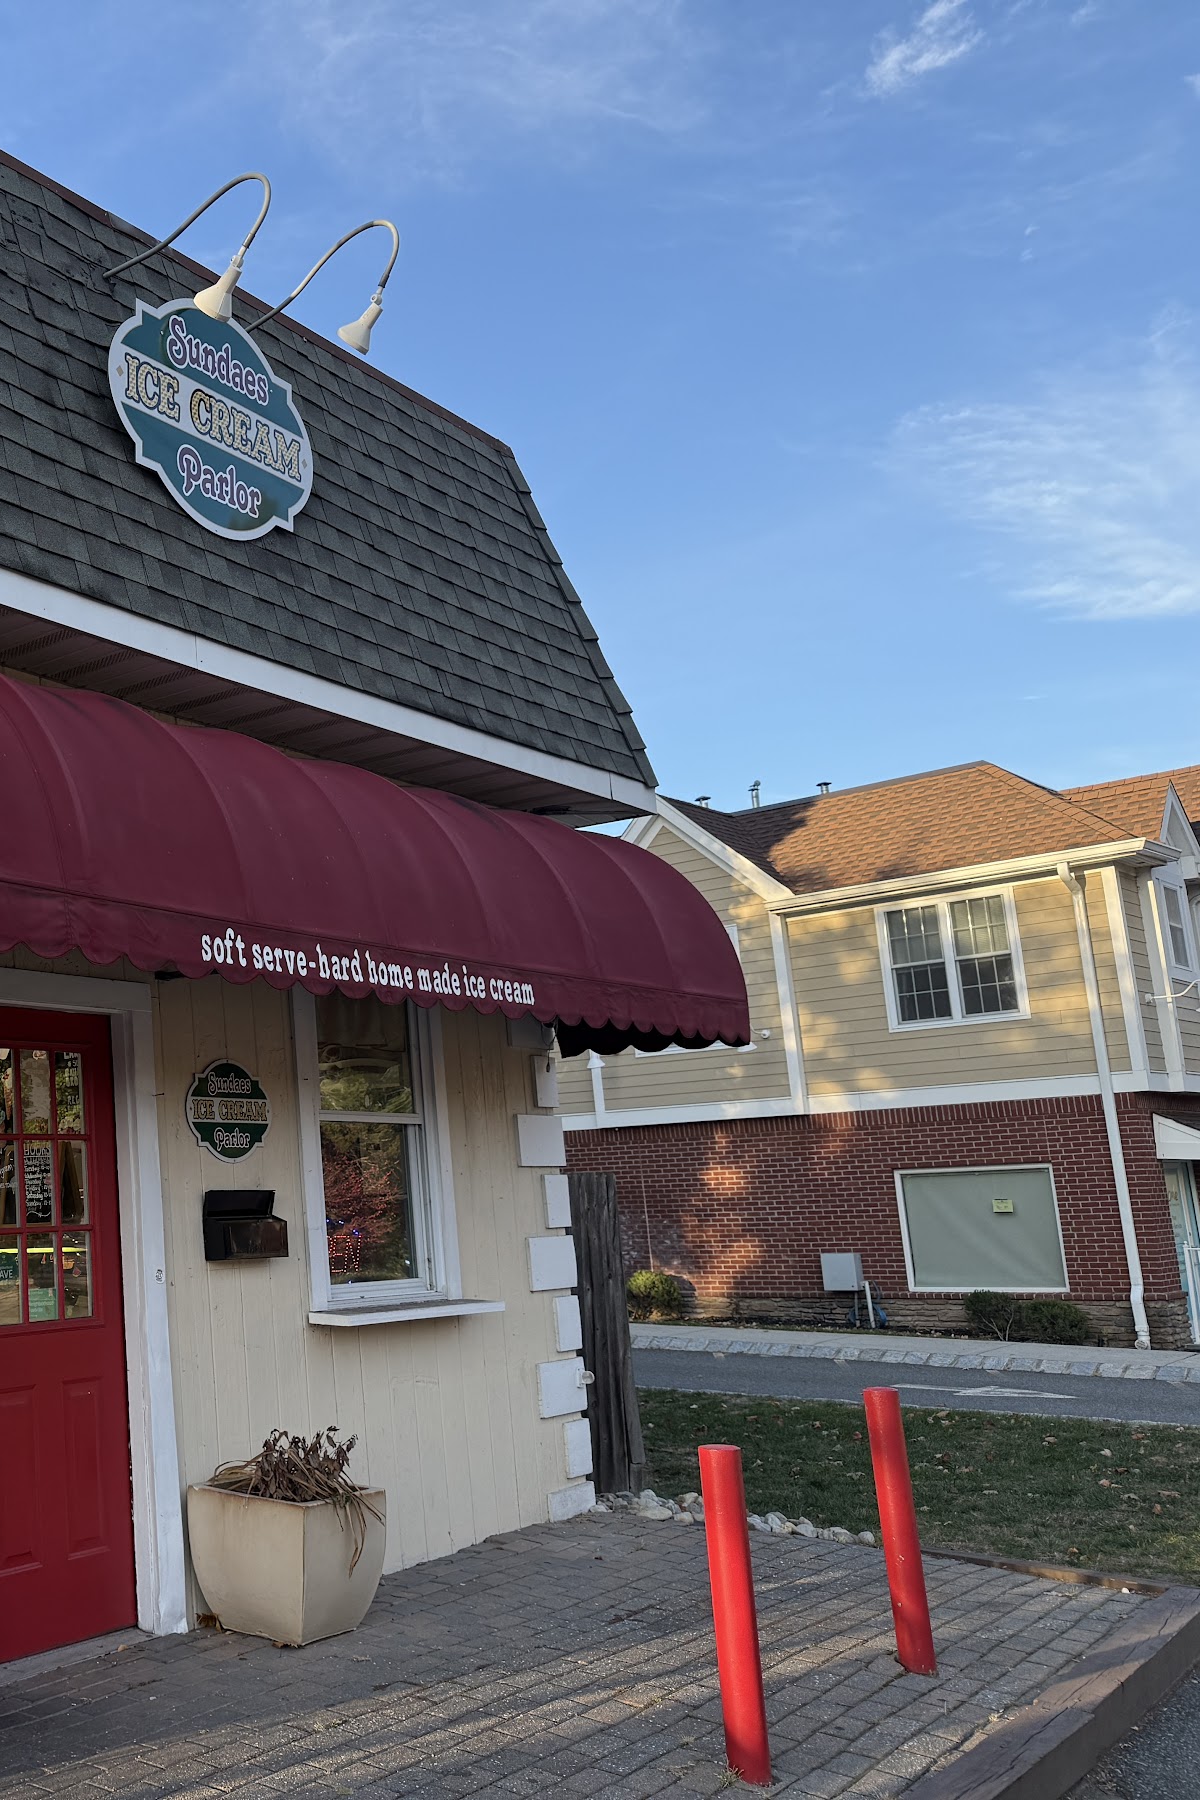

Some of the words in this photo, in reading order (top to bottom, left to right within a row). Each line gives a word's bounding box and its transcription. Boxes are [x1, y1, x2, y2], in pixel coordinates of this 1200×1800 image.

[167, 315, 268, 406] Sundaes
[125, 354, 180, 421] ICE
[190, 389, 301, 482] CREAM
[177, 444, 261, 518] Parlor
[201, 928, 247, 967] soft
[364, 950, 413, 990] home
[417, 962, 461, 996] made
[462, 965, 486, 999] ice
[489, 978, 536, 1006] cream
[192, 1099, 216, 1120] ICE
[218, 1100, 268, 1122] CREAM
[208, 1072, 251, 1095] Sundaes
[214, 1127, 250, 1151] Parlor
